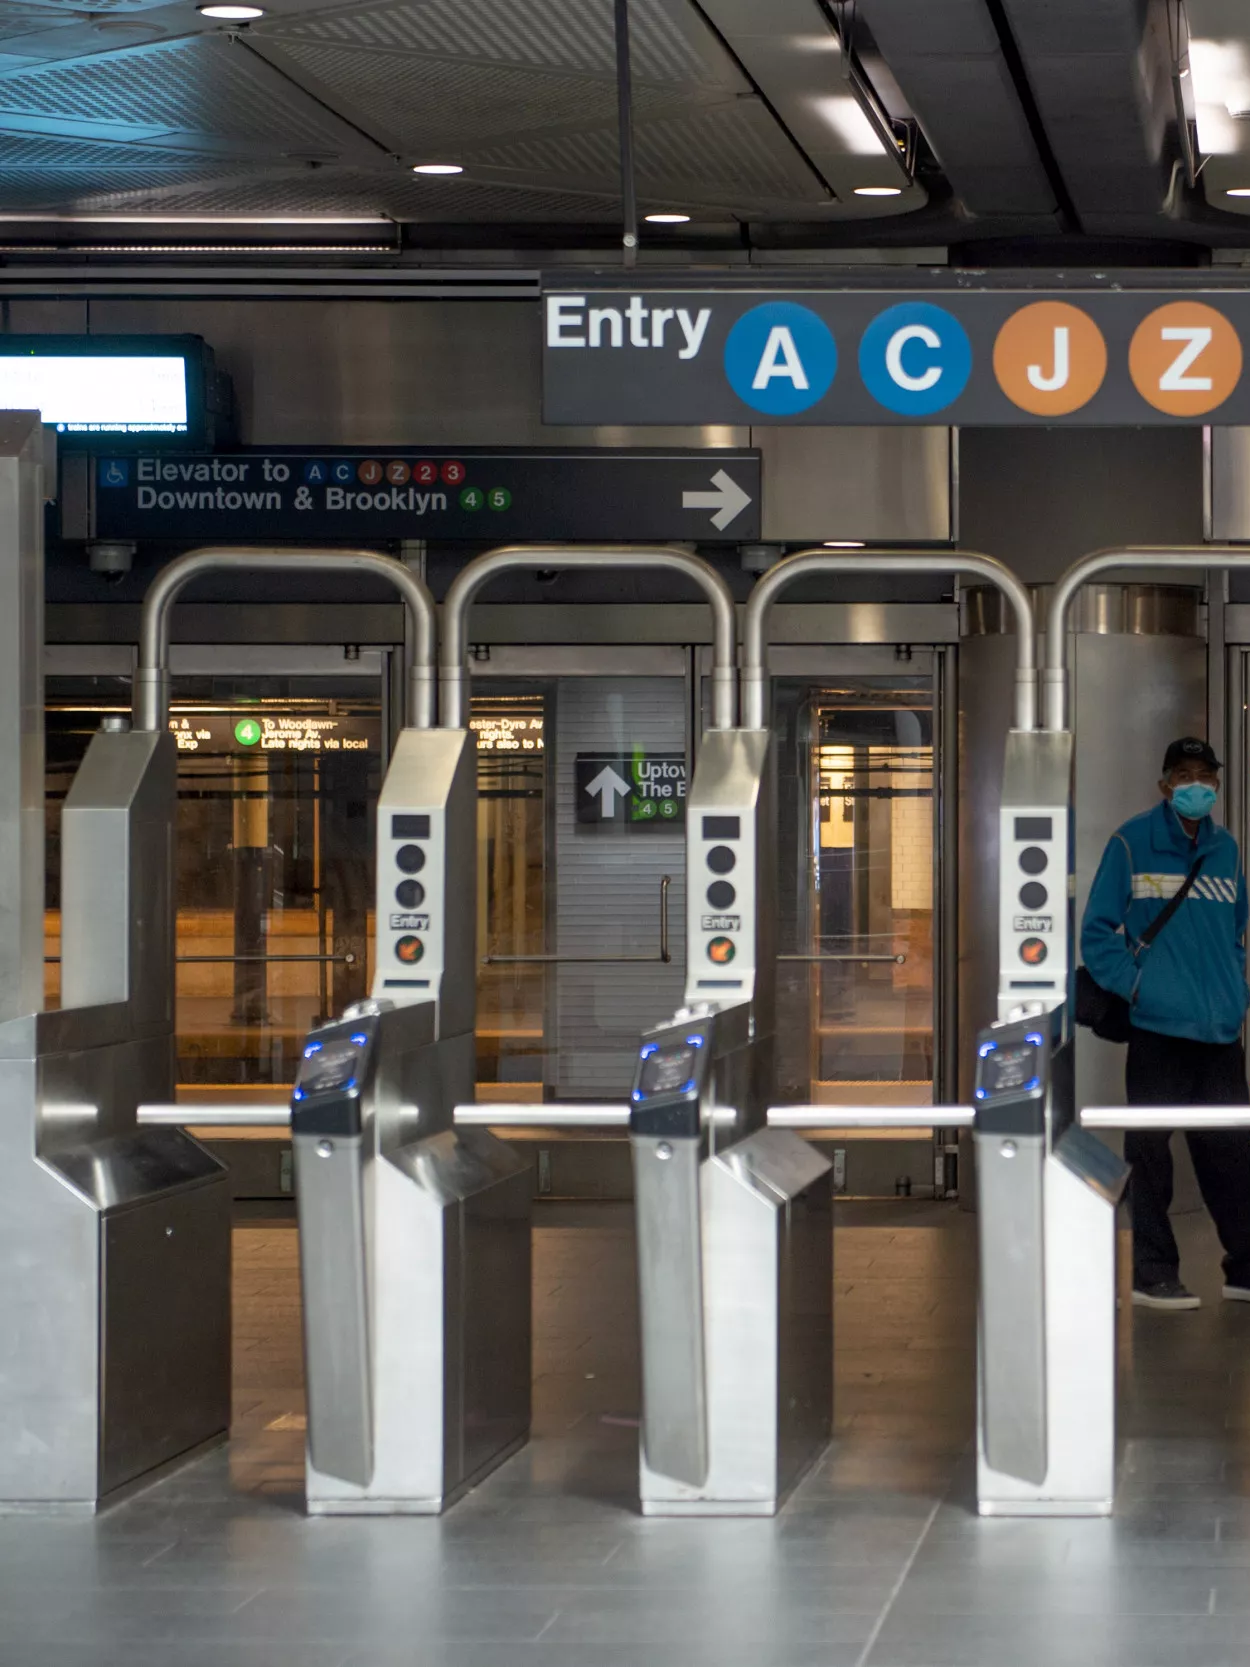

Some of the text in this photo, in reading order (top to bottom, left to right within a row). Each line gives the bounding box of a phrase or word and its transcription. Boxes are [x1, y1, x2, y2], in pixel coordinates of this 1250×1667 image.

[546, 296, 711, 360] Entry
[752, 326, 810, 390] A
[886, 325, 943, 392] C
[1027, 327, 1070, 392] J
[1159, 327, 1213, 391] Z
[137, 459, 460, 482] Elevator to A C J Z 2 3
[137, 486, 505, 515] Downtown & Brooklyn 4 5
[262, 719, 338, 730] To Woodlawn-
[195, 729, 211, 740] via
[240, 724, 253, 740] 4
[261, 729, 321, 739] Jerome Av.
[479, 729, 514, 741] nights.
[177, 739, 199, 750] Exp
[261, 738, 368, 750] Late nights via local
[496, 740, 520, 749] also
[522, 739, 535, 749] to
[638, 781, 672, 797] The
[643, 803, 673, 814] 4 5
[391, 915, 429, 931] Entry
[702, 916, 740, 931] Entry
[1014, 917, 1052, 932] Entry
